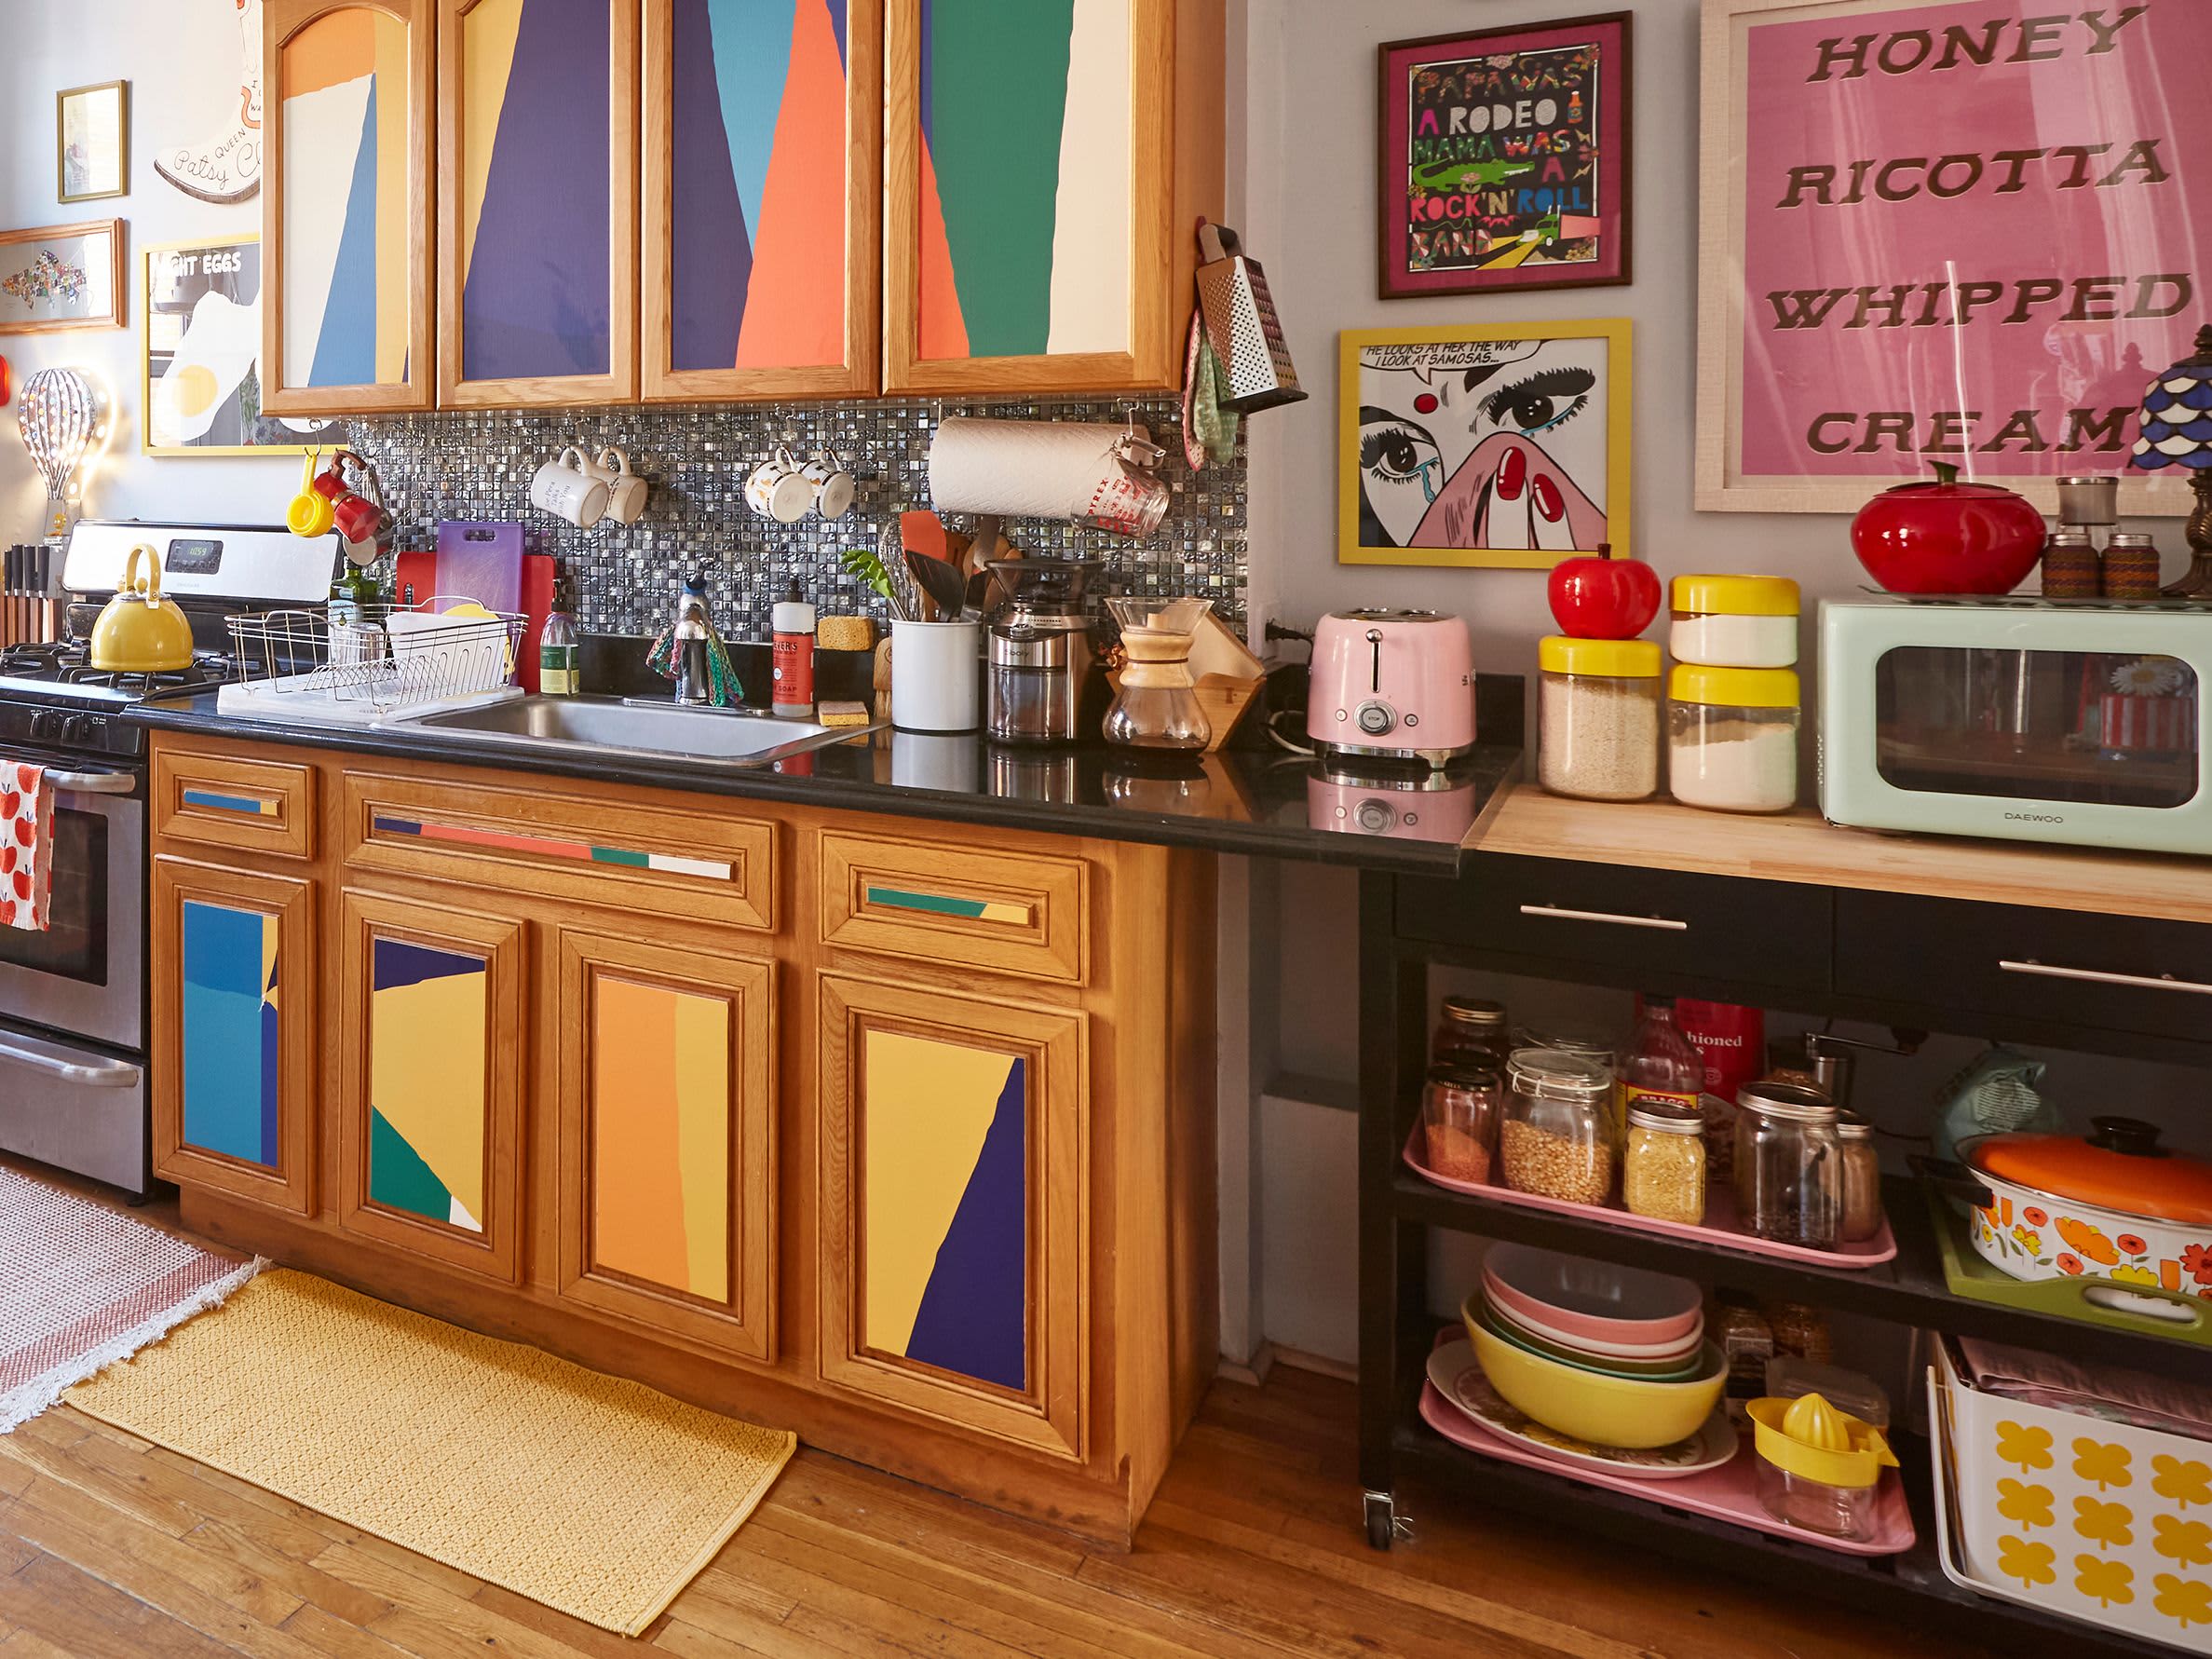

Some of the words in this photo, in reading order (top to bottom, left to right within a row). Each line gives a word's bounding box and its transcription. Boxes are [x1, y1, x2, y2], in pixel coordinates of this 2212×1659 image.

[1805, 5, 2151, 84] HONEY
[1418, 70, 1506, 104] PAPA
[1509, 63, 1581, 92] WAS
[1418, 109, 1440, 136] A
[1449, 98, 1557, 135] RODEO
[215, 128, 246, 158] QUEEN
[1414, 133, 1496, 164] MAMA
[1503, 129, 1571, 157] WAS
[174, 150, 229, 190] Patsy
[1541, 156, 1566, 183] A
[1775, 139, 2171, 210] RICOTTA
[1412, 228, 1493, 258] BAND
[202, 251, 241, 275] EGGS
[1766, 273, 2192, 330] WHIPPED
[1366, 346, 1382, 356] HE
[1384, 344, 1424, 356] LOOKS
[1425, 343, 1440, 353] AT
[1443, 343, 1466, 353] HER
[1470, 342, 1491, 352] THE
[1495, 340, 1521, 351] WAY
[1375, 356, 1381, 366] I
[1381, 355, 1412, 366] LOOK
[1412, 354, 1428, 365] AT
[1428, 352, 1500, 366] SAMOSAS...
[1806, 406, 2139, 456] CREAM
[1088, 479, 1108, 515] PYREX
[2004, 812, 2064, 823] DAEWOO
